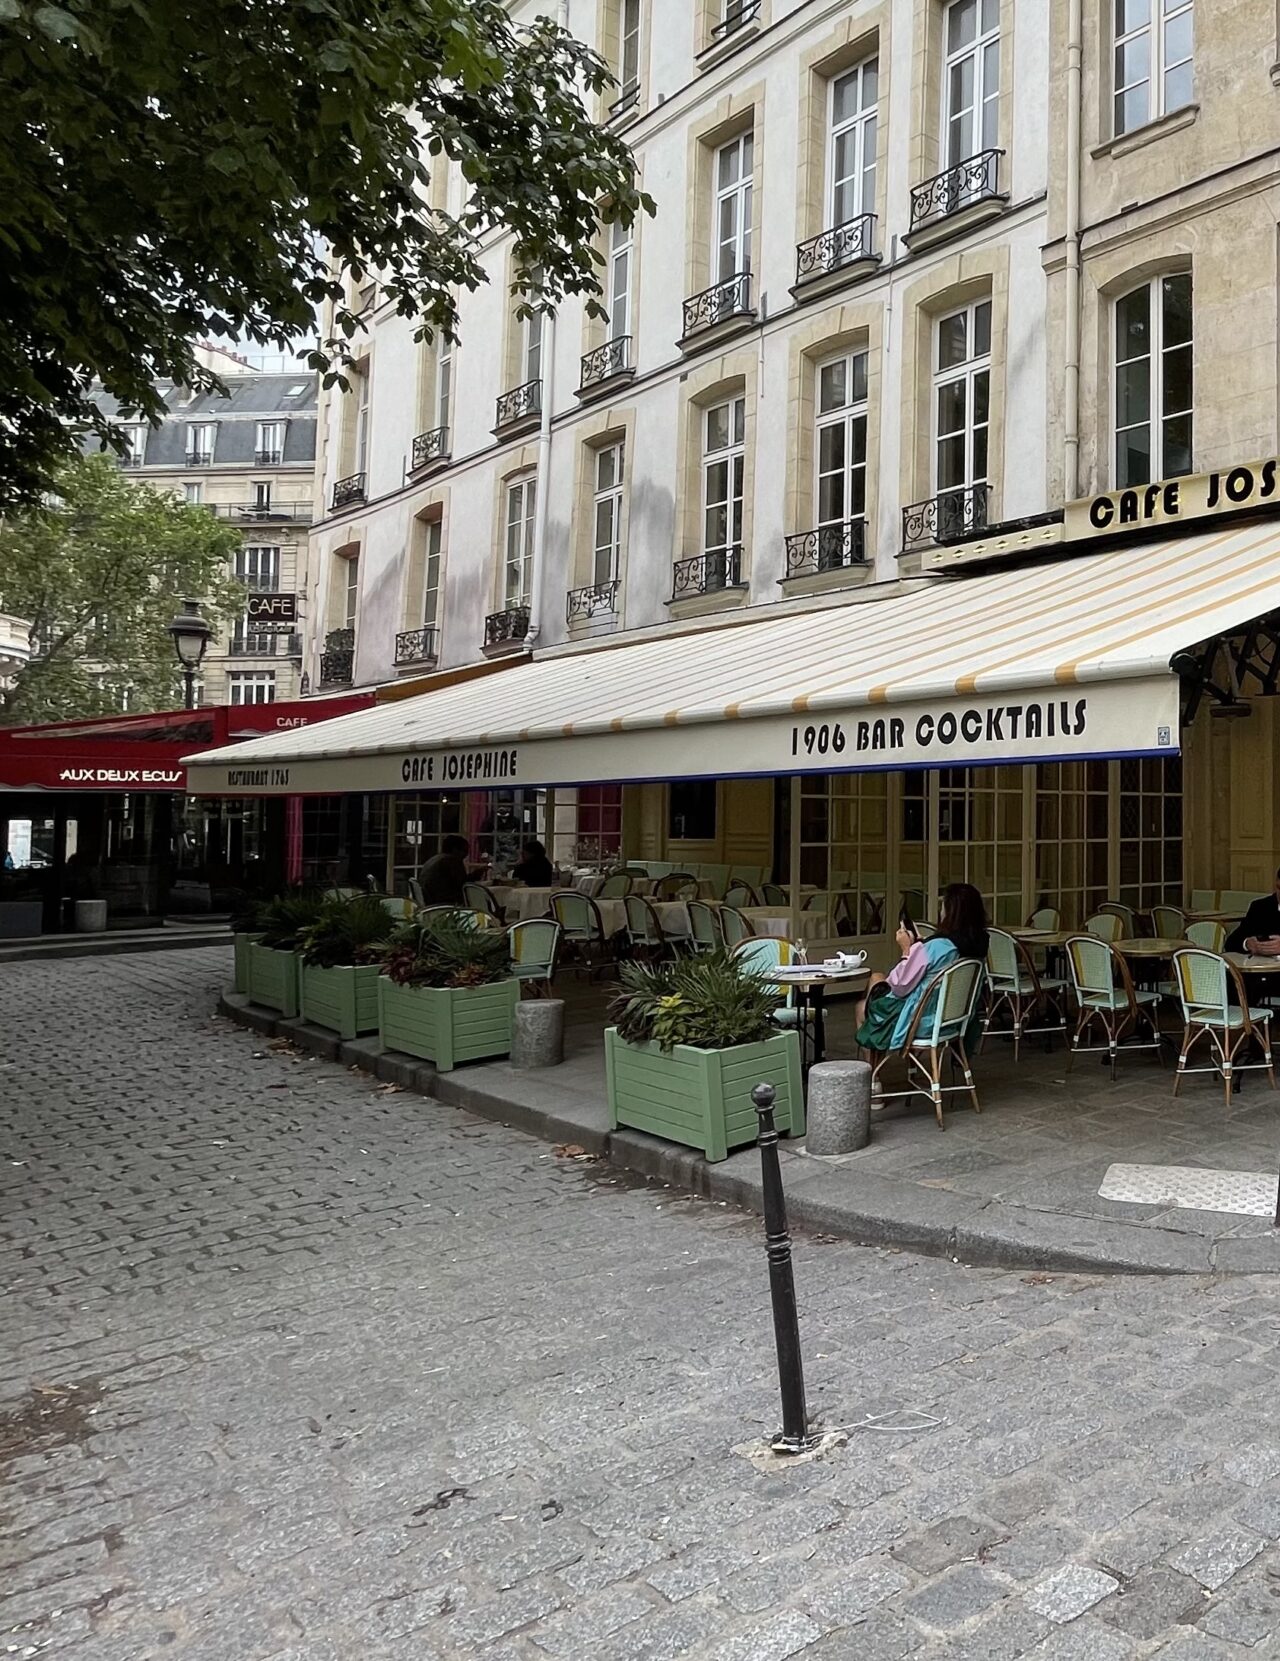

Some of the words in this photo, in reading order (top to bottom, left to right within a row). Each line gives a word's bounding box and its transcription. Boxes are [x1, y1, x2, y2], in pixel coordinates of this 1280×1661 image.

[1089, 482, 1179, 529] CAFE
[248, 598, 293, 615] CAFE
[792, 723, 846, 756] 1906
[856, 717, 905, 752] BAR
[915, 699, 1087, 747] COCKTAILS
[59, 769, 95, 781] AUX
[97, 769, 139, 782] DEUX
[142, 769, 183, 782] ECUS
[402, 757, 433, 783] CAFE
[442, 750, 517, 782] JOSEPHINE
